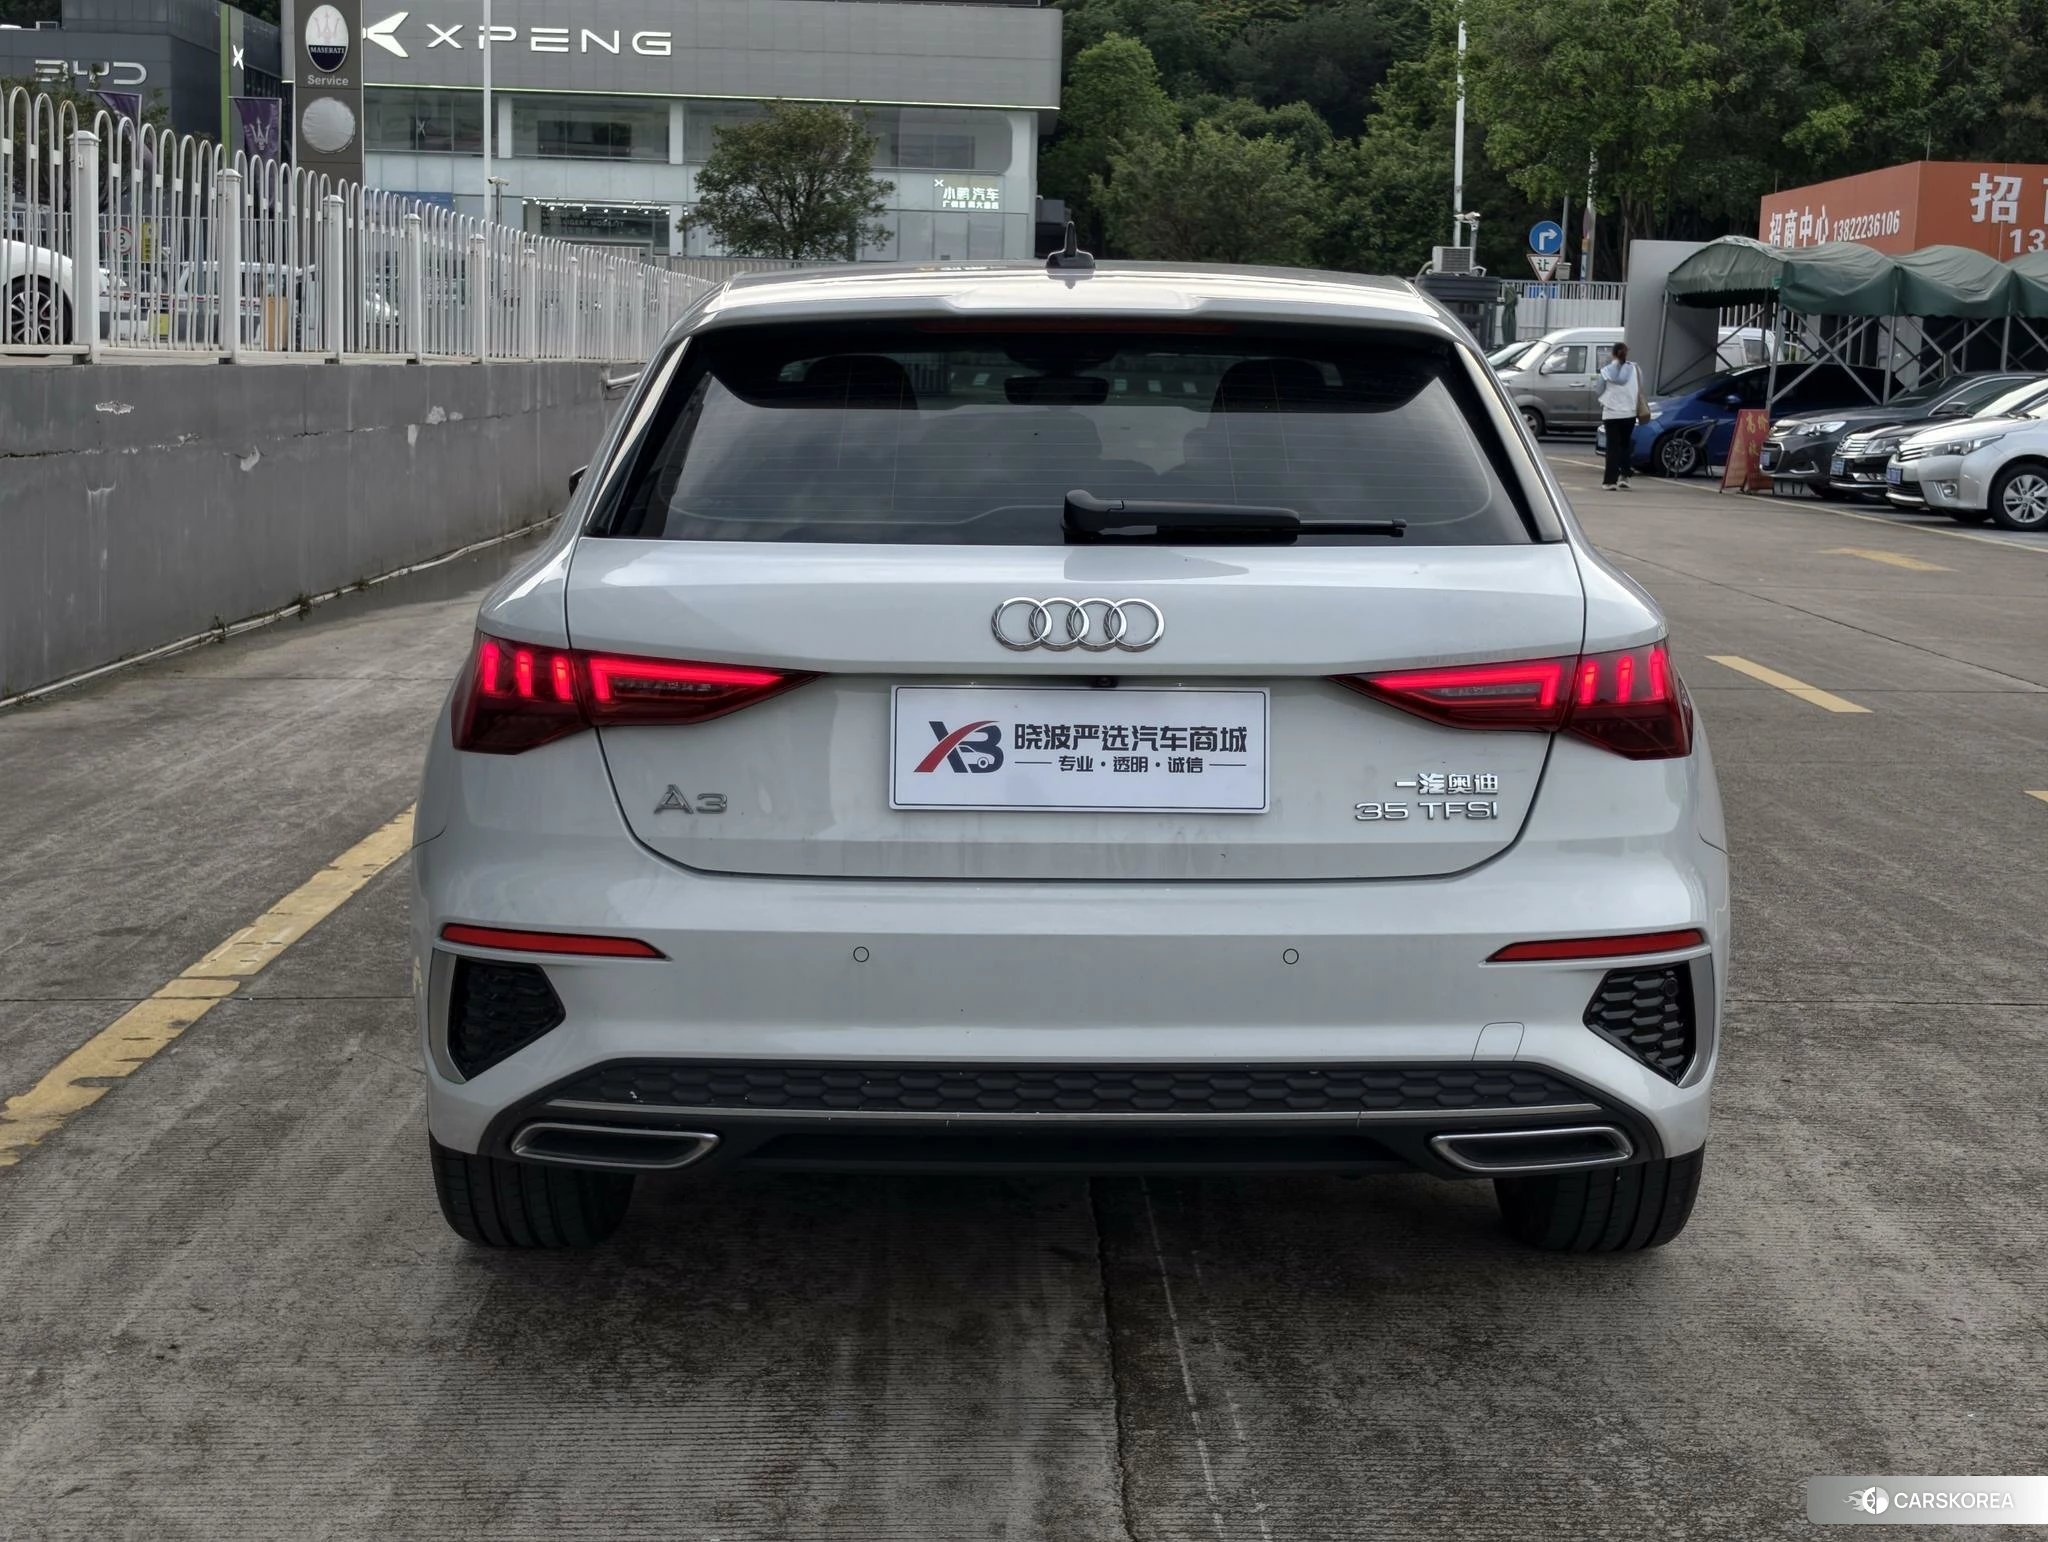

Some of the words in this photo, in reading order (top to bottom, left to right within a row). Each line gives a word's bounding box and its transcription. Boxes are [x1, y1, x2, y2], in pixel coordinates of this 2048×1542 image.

[310, 46, 345, 54] MASERATI
[426, 23, 672, 56] XPENG
[35, 59, 147, 85] BYD
[307, 74, 349, 86] Service
[1970, 172, 2048, 225] 招
[1769, 204, 1829, 248] 招商中心
[1833, 209, 1900, 242] 13822236106
[1537, 258, 1550, 273] 让
[1014, 723, 1247, 753] 晓波严选汽车商城
[1395, 773, 1499, 795] 一汽奥迪
[653, 783, 728, 815] A3
[1355, 802, 1410, 821] 35
[1418, 801, 1499, 820] TFSI
